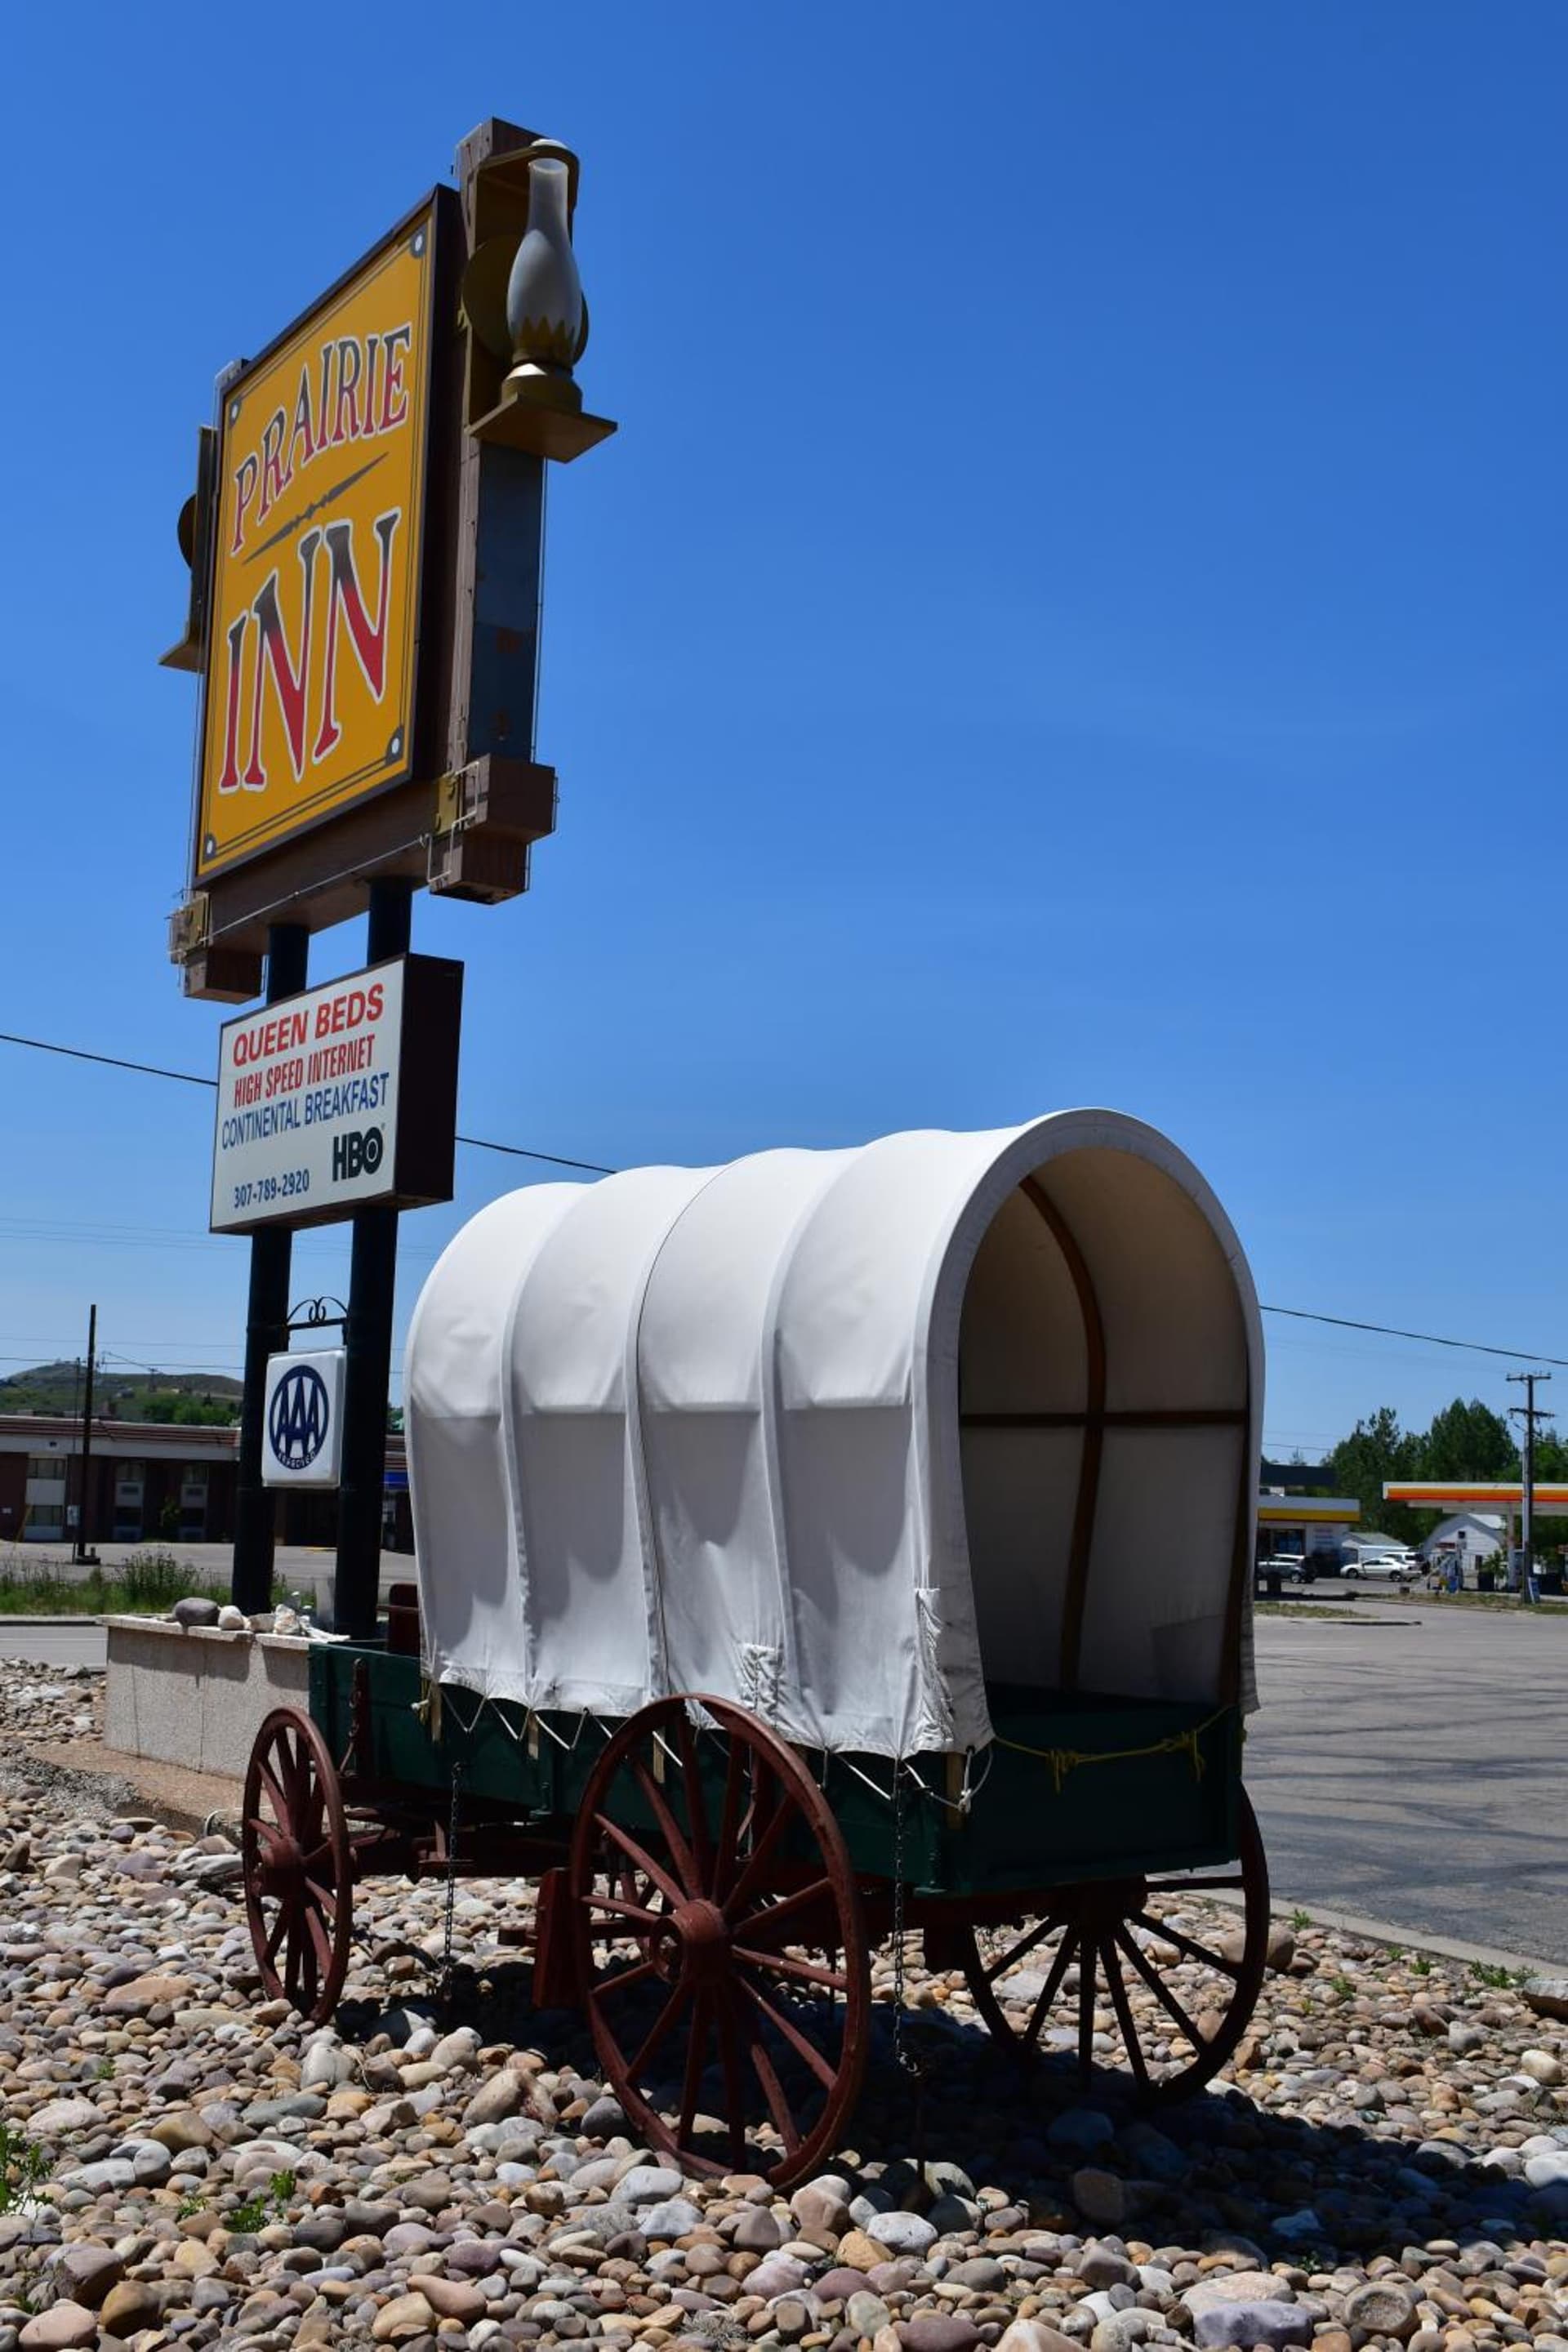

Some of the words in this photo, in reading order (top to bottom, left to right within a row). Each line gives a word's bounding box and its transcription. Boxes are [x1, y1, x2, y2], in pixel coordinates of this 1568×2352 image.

[230, 321, 412, 557] PRAIRIE
[218, 506, 402, 794] INN
[233, 1010, 310, 1067] QUEEN
[314, 983, 384, 1040] BEDS
[221, 1099, 301, 1150] CONTINENTAL
[305, 1072, 390, 1125] BREAKFAST
[234, 1071, 262, 1108] HIGH
[265, 1061, 304, 1098] SPEED
[307, 1034, 376, 1083] INTERNET
[234, 1169, 310, 1209] 307-789-2920
[332, 1126, 383, 1182] HBO
[274, 1375, 319, 1459] AAA
